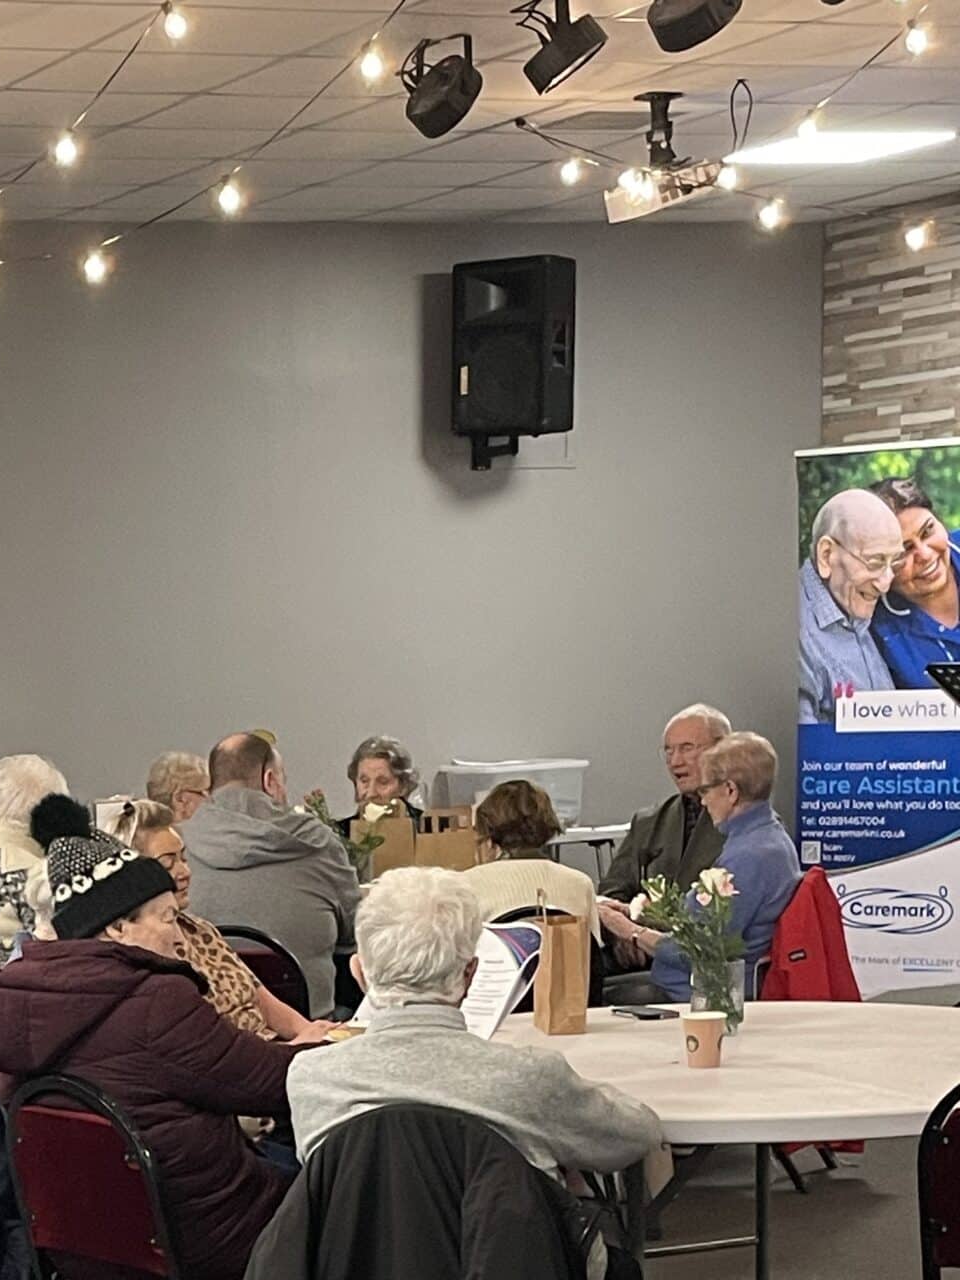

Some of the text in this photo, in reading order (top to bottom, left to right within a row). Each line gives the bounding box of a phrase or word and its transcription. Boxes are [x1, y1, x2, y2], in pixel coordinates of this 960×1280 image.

[853, 701, 893, 718] love
[898, 700, 947, 718] what
[801, 759, 946, 772] Join our team of wonderful
[802, 773, 960, 795] Care Assistant
[801, 799, 820, 810] and
[821, 799, 850, 812] you'll
[852, 799, 875, 810] love
[876, 799, 903, 810] what
[905, 801, 926, 812] you
[927, 799, 943, 810] do
[849, 901, 937, 918] Caremark
[902, 957, 954, 968] EXCELLENT
